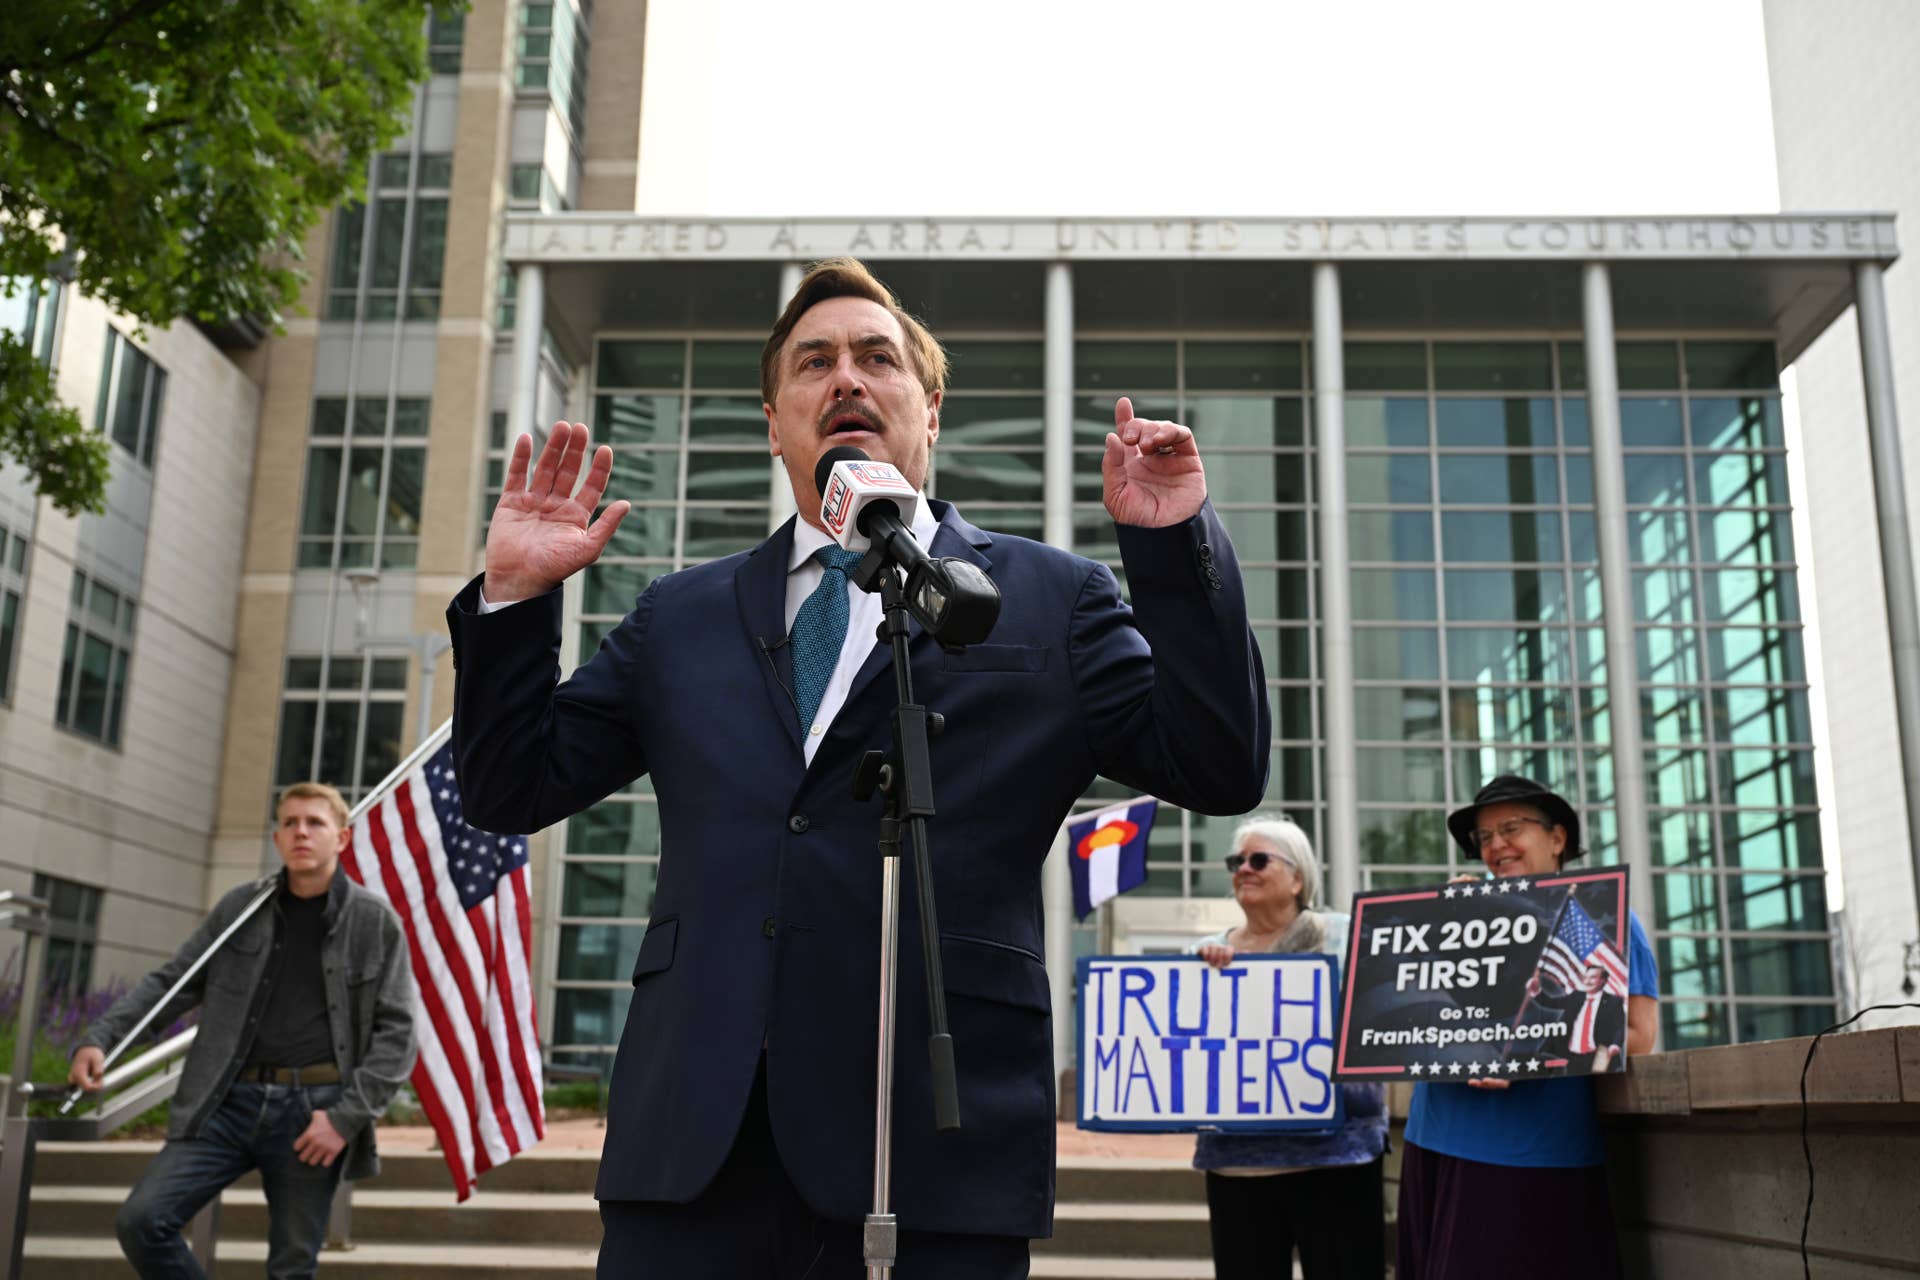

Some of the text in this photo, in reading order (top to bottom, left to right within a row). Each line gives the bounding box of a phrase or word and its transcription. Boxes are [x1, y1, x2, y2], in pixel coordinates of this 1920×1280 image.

[543, 222, 728, 251] ALFRED
[849, 221, 1016, 251] ARRAJ
[1055, 219, 1243, 251] UNITED
[1284, 220, 1468, 251] STATES
[1503, 220, 1866, 251] COURTHOUSE
[1370, 914, 1538, 956] FIX 2020
[1396, 956, 1506, 991] FIRST
[1089, 967, 1322, 1038] TRUTH
[1440, 1006, 1490, 1021] Go To:
[1361, 1022, 1568, 1048] FrankSpeech.com
[1093, 1036, 1334, 1114] MATTERS
